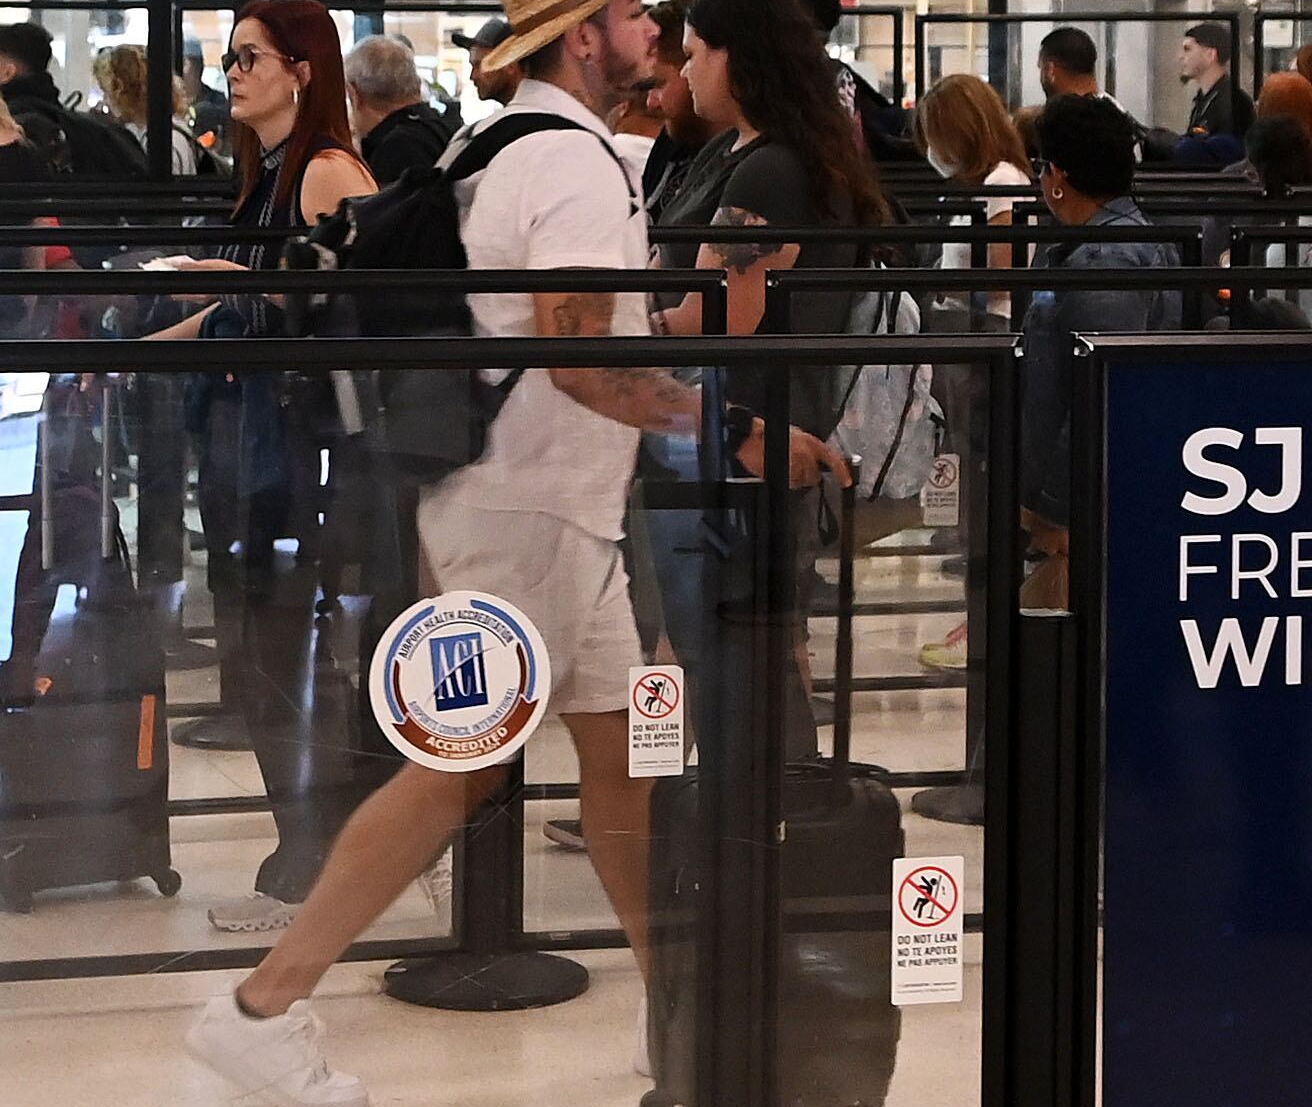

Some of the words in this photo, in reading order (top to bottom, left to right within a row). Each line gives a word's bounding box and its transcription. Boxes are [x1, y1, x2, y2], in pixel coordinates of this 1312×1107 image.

[398, 626, 425, 659] AIRPORT
[437, 638, 485, 700] ACI
[632, 724, 643, 733] DO
[645, 723, 659, 732] NOT
[661, 723, 680, 732] LEAN
[425, 727, 508, 752] ACCREDITED
[632, 734, 643, 742] NO
[897, 935, 911, 945] DO
[913, 934, 931, 944] NOT
[934, 933, 958, 943] LEAN
[897, 948, 909, 957] NO
[912, 947, 922, 956] TE
[924, 945, 957, 955] APOYES
